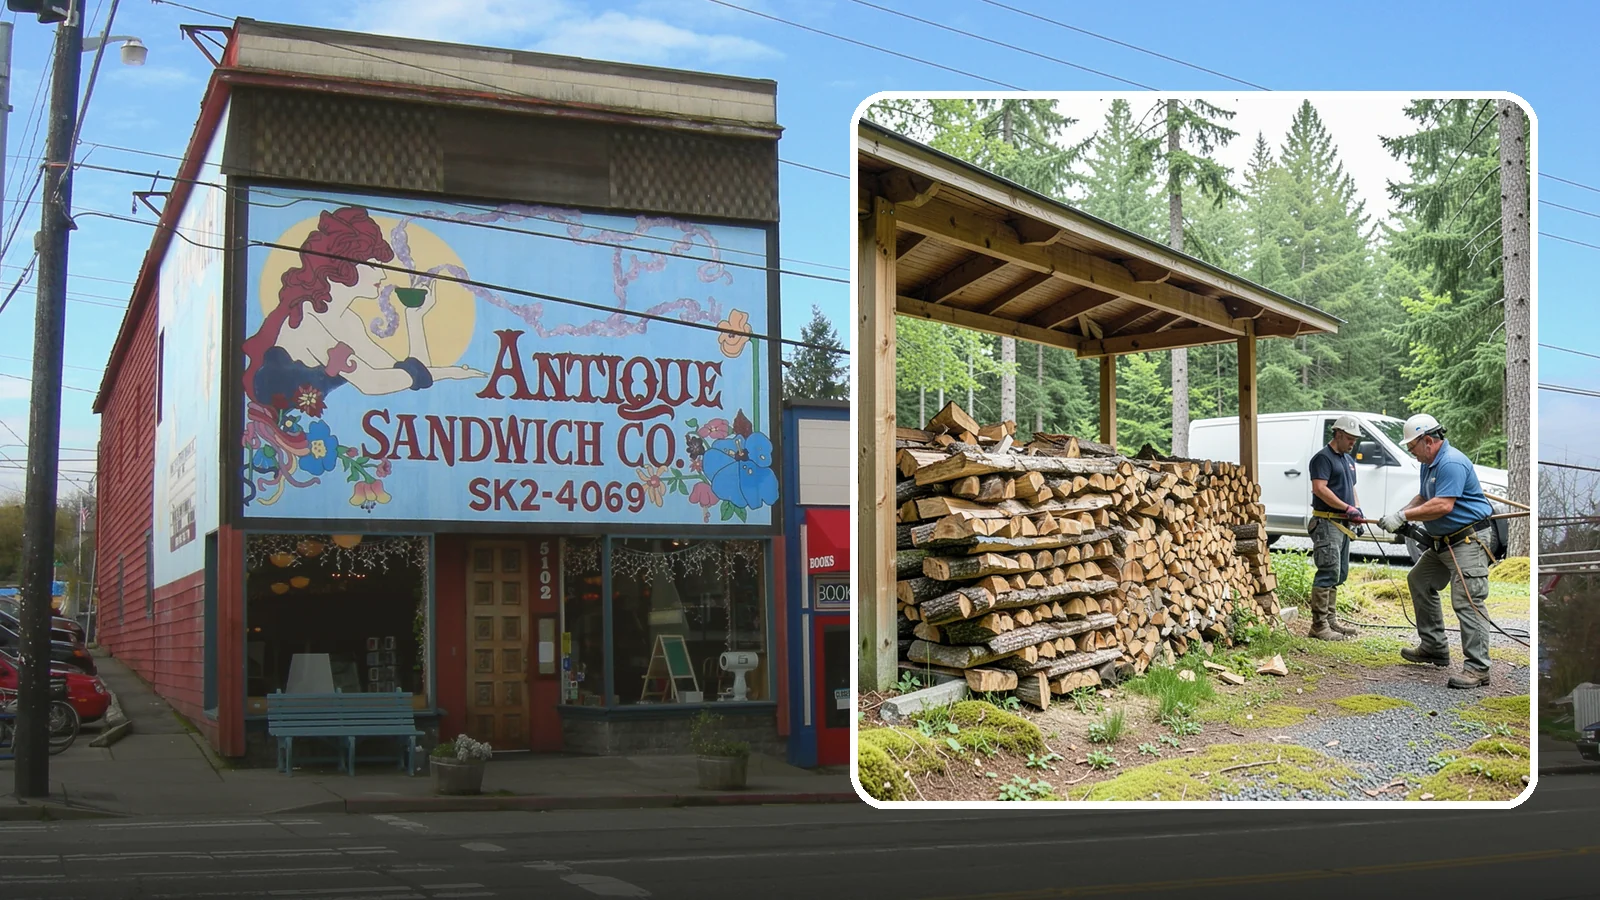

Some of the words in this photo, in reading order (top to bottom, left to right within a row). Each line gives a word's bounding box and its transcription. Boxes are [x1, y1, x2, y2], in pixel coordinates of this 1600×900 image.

[476, 329, 723, 420] ANTIQUE
[361, 408, 604, 467] SANDWICH
[617, 423, 684, 468] CO.
[469, 477, 645, 512] SK2-4069
[540, 541, 551, 599] 5102
[809, 555, 835, 569] BOOKS
